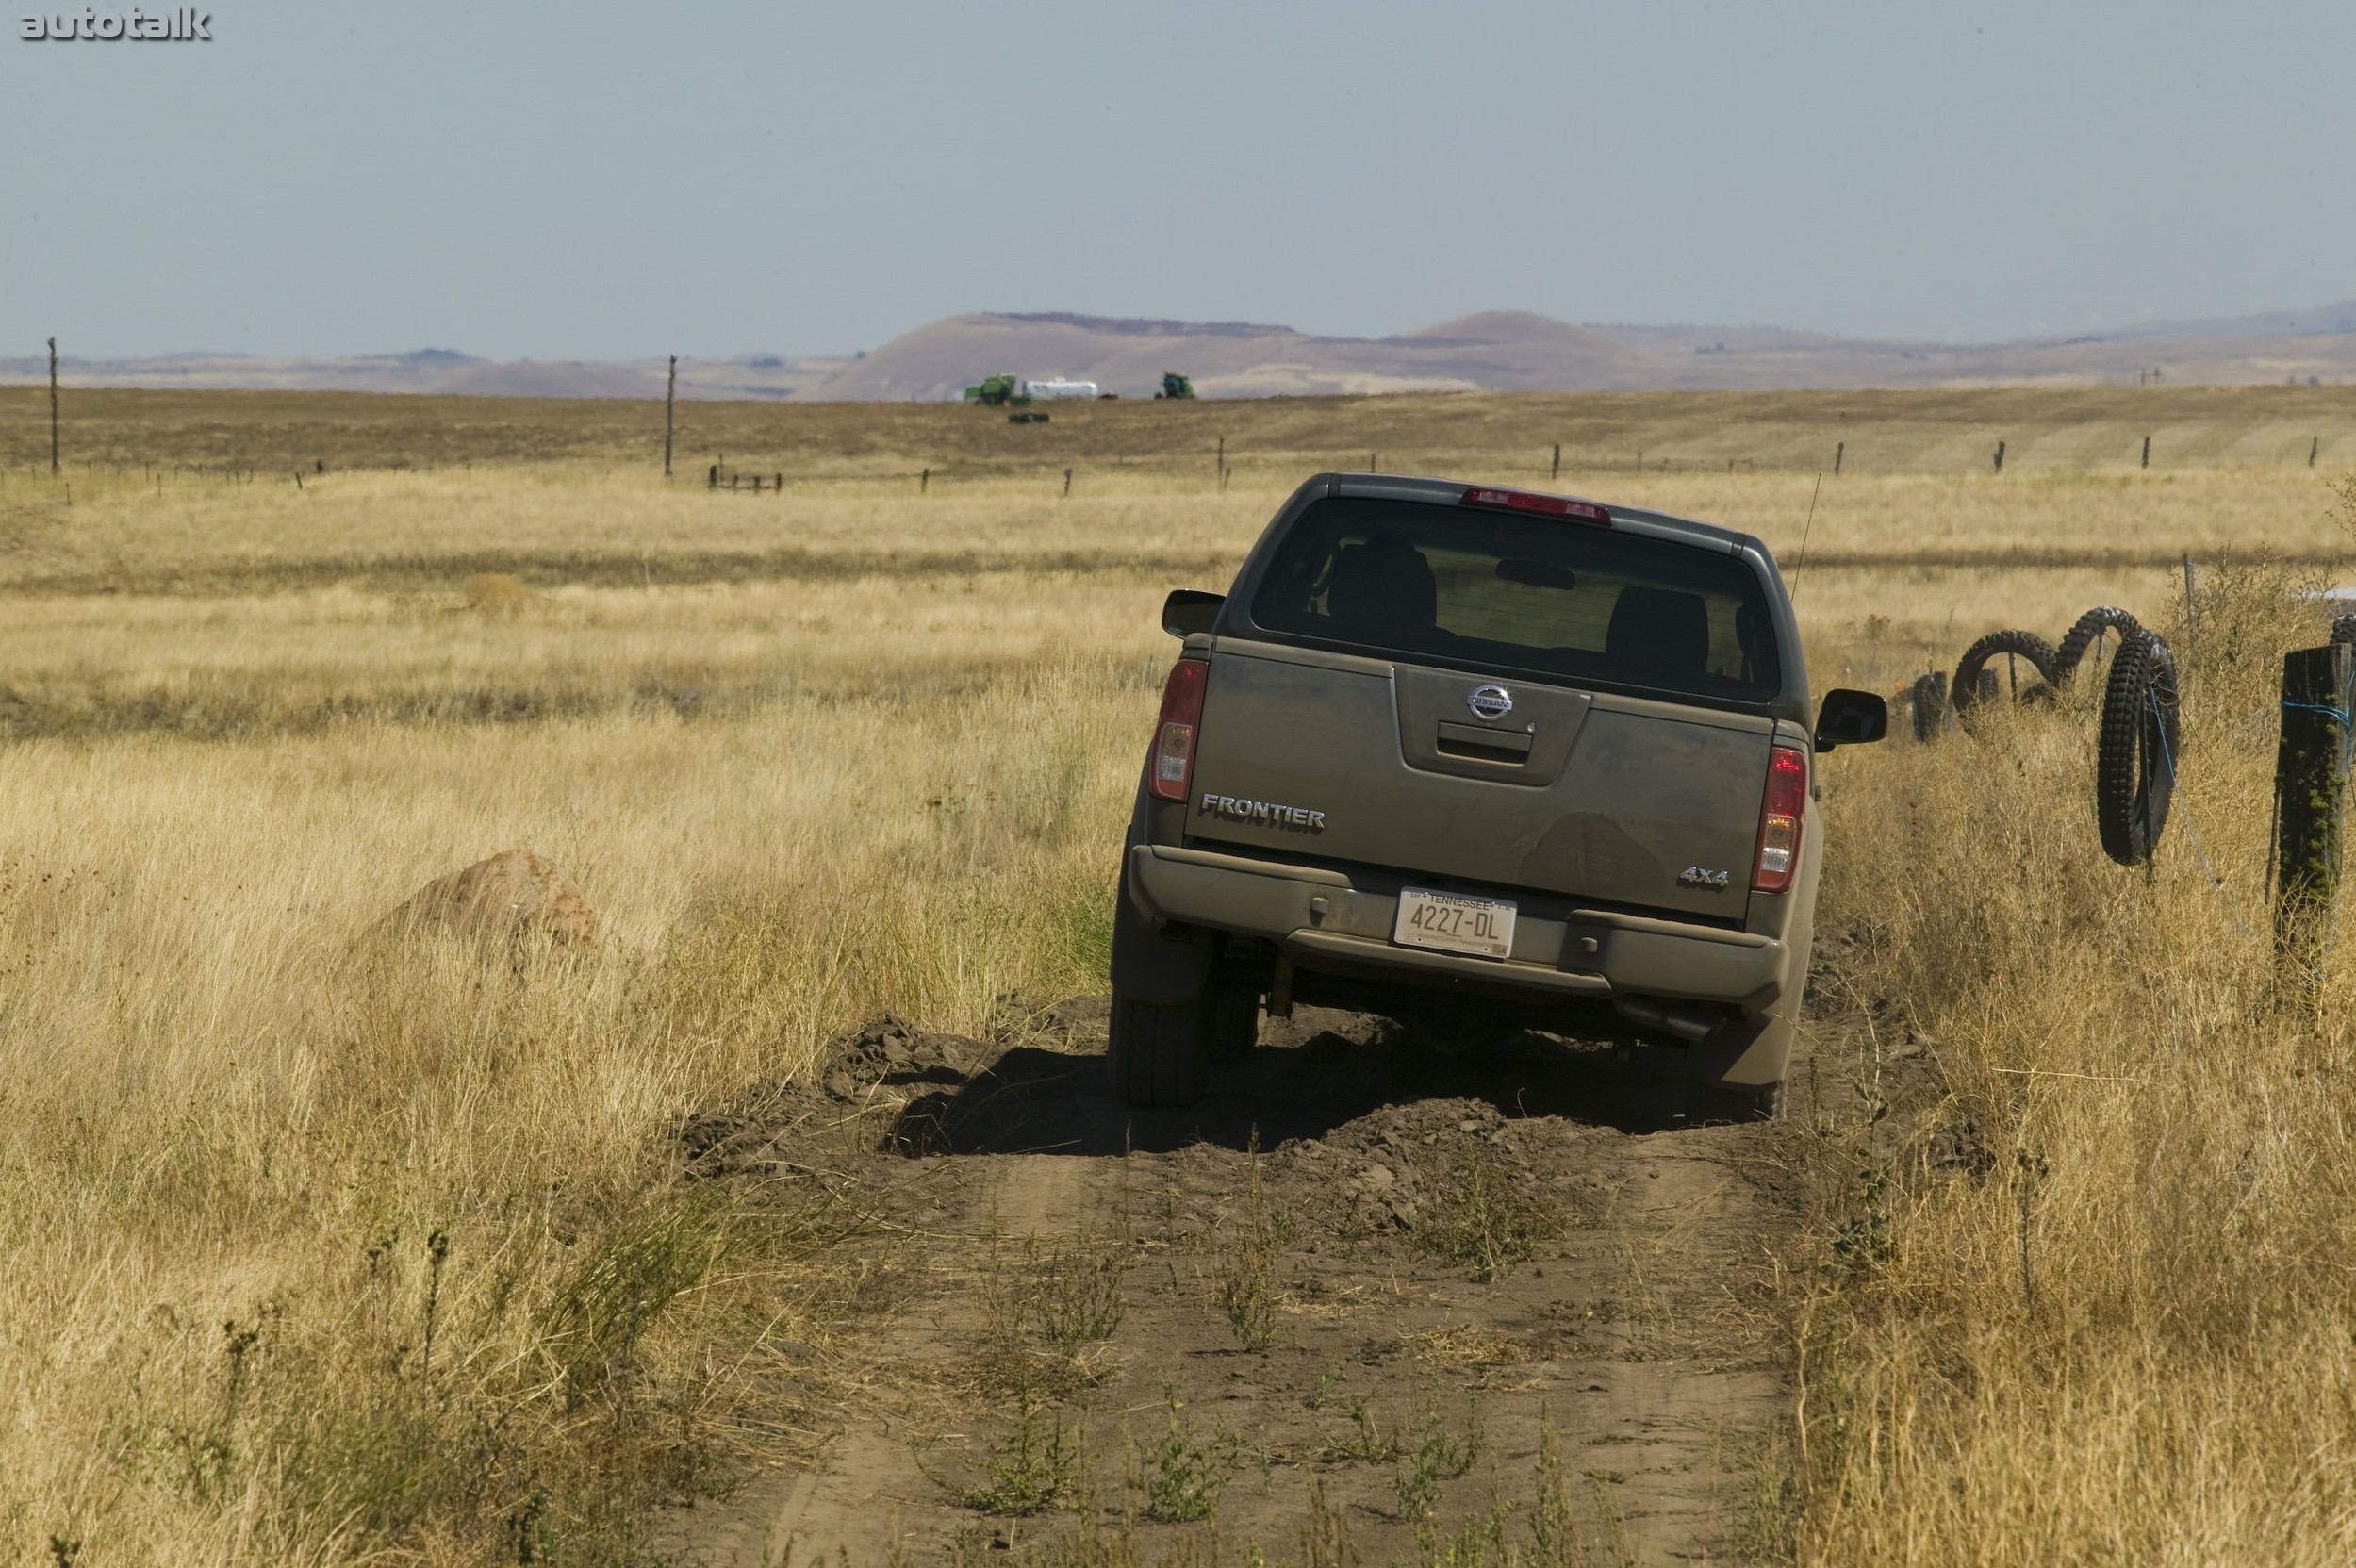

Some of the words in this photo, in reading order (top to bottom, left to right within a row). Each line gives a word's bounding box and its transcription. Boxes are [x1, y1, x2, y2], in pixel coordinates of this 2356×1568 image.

[1472, 698, 1508, 708] NISSAN
[1201, 793, 1326, 829] FRONTIER
[1429, 894, 1491, 911] TENNESSEE
[1410, 903, 1499, 940] 4227-DL
